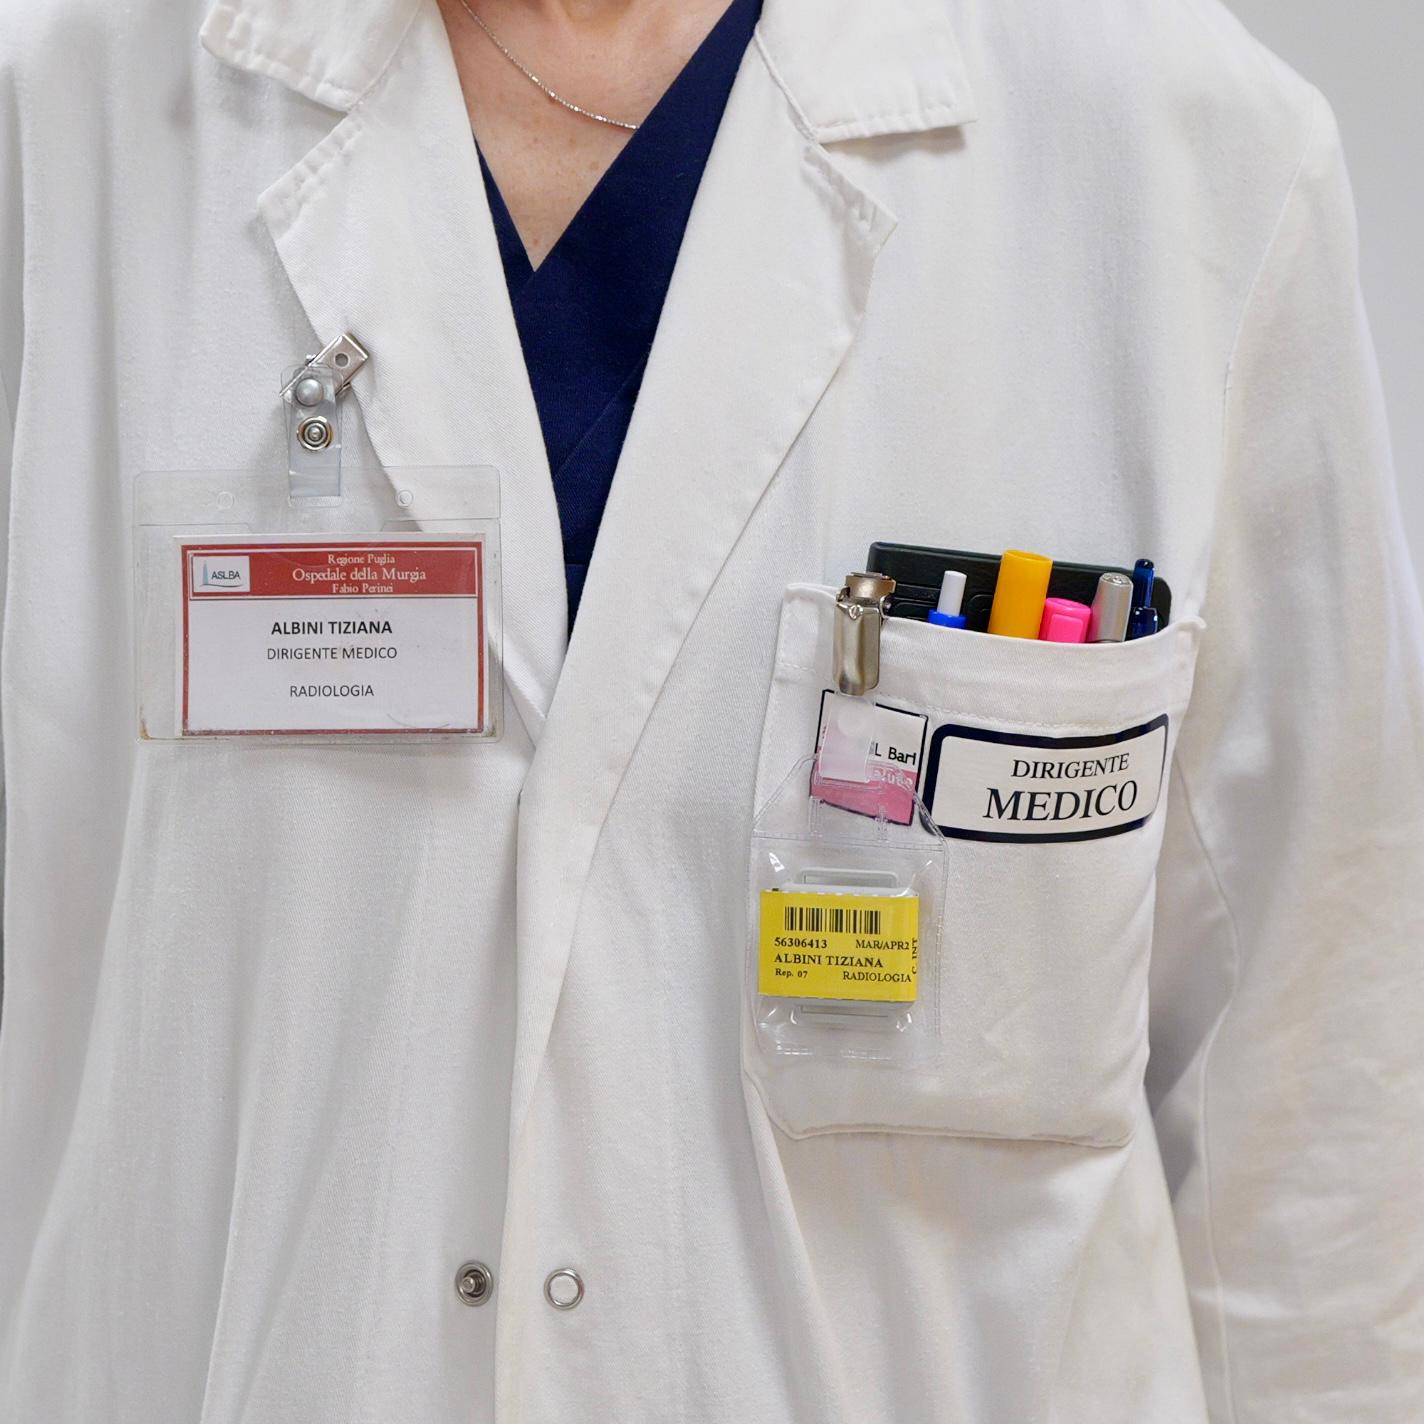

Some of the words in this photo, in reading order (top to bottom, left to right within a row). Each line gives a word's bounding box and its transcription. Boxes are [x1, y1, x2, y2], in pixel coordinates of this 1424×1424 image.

[327, 553, 365, 566] Regione
[367, 552, 396, 566] Puglia
[292, 567, 347, 584] Ospedale
[350, 567, 378, 581] della
[382, 567, 427, 584] Murgia
[332, 583, 359, 594] Fabio
[362, 582, 394, 594] Perinei
[271, 621, 324, 636] ALBINI
[327, 620, 393, 635] TIZIANA
[267, 647, 338, 660] DIRIGENTE
[341, 647, 398, 659] MEDICO
[289, 684, 375, 697] RADIOLOGIA
[887, 746, 918, 766] Bari
[1010, 752, 1131, 780] DIRIGENTE
[982, 779, 1139, 822] MEDICO
[774, 936, 828, 949] 56306413
[774, 953, 822, 966] ALBINI
[825, 955, 884, 969] TIZIANA
[775, 967, 794, 979] Rep.
[797, 970, 809, 979] 07
[842, 971, 912, 983] RADIOLOGIA
